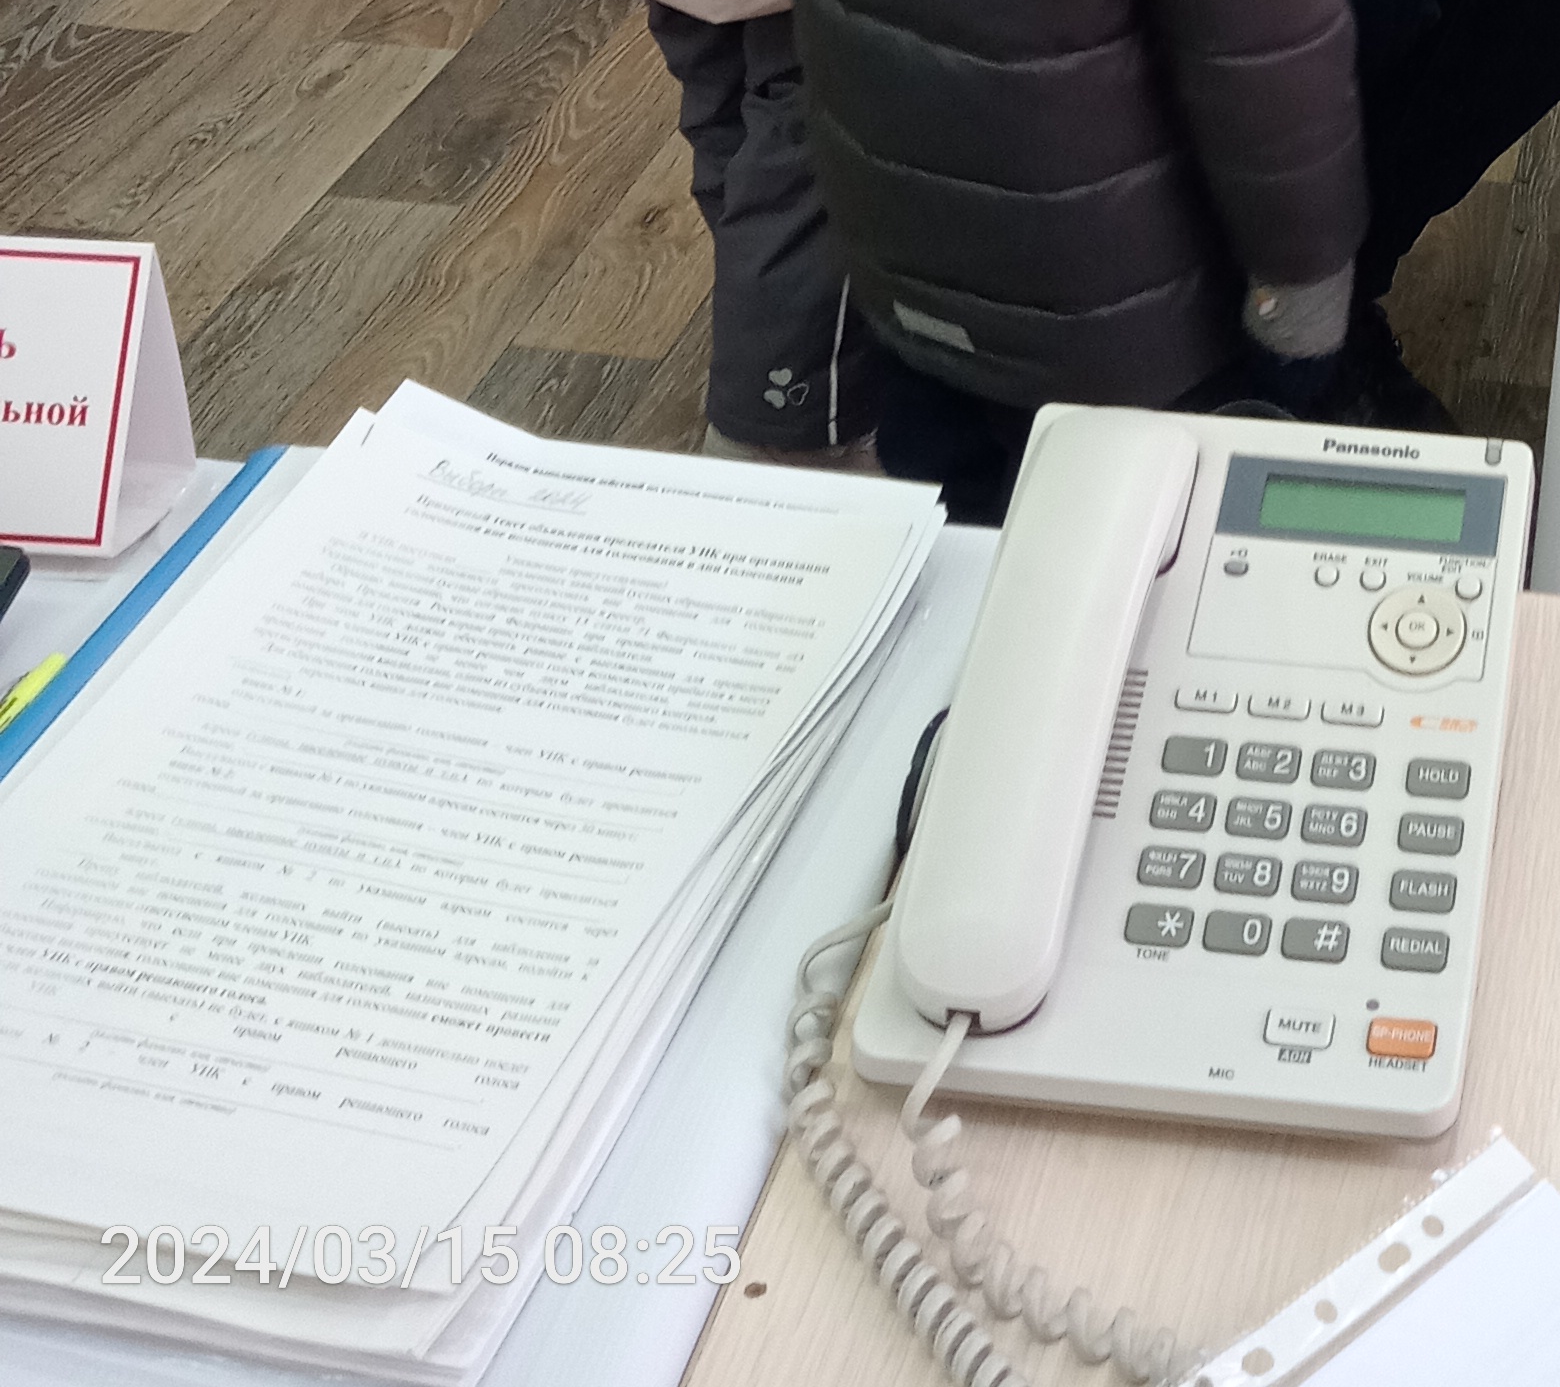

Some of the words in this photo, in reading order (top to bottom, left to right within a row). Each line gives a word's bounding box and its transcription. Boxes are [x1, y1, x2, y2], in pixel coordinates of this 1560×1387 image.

[1323, 438, 1420, 460] Panasonic
[1364, 557, 1388, 568] EXIT
[1204, 742, 1216, 768] 1
[1273, 749, 1293, 775] 2
[1349, 757, 1367, 782] 3
[1418, 768, 1459, 783] HOLD
[1188, 797, 1206, 823] 4
[1264, 804, 1283, 830] 5
[1340, 812, 1358, 838] 6
[1408, 822, 1455, 838] PAUSE
[1178, 853, 1197, 880] 7
[1252, 859, 1272, 887] 8
[1331, 868, 1350, 894] 9
[1400, 880, 1449, 897] FLASH
[1136, 949, 1170, 962] TONE
[1390, 937, 1443, 955] REDIAL
[1278, 1018, 1322, 1034] MUTE
[1208, 1066, 1235, 1080] MIC
[1368, 1057, 1428, 1073] HEADSET
